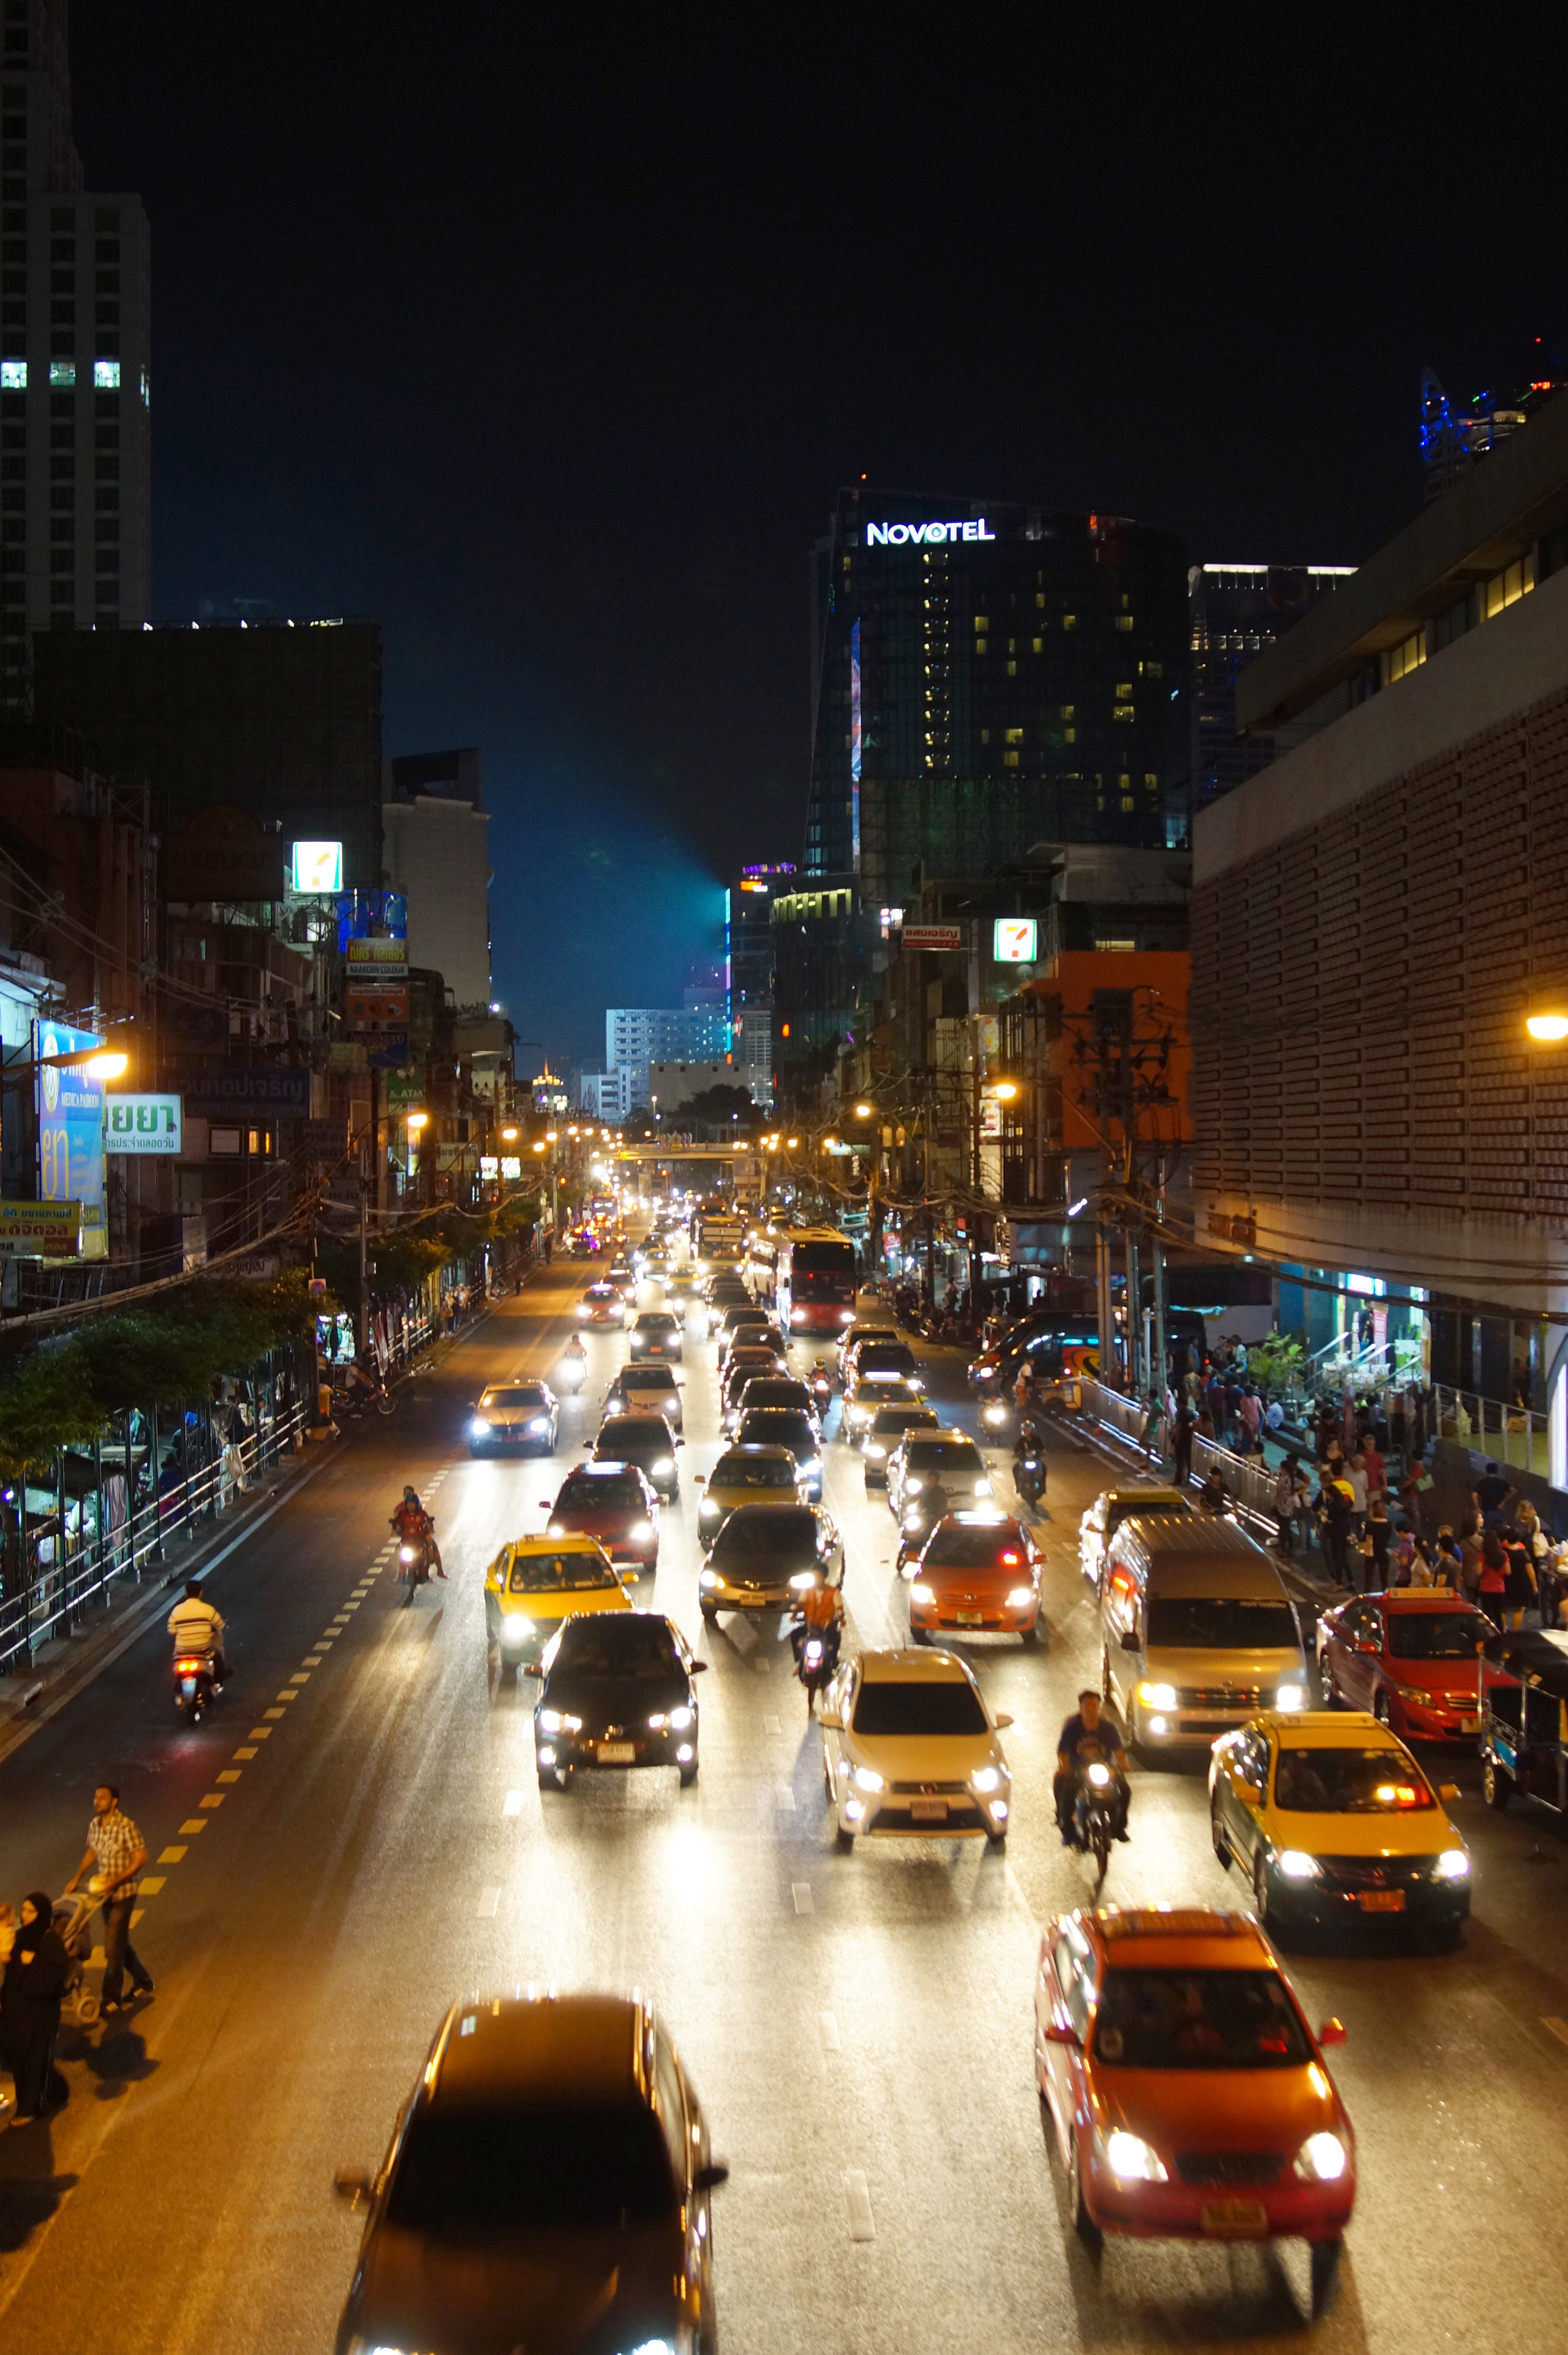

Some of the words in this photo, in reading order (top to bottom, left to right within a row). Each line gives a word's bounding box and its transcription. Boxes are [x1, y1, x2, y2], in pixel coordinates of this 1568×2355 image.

[867, 518, 996, 546] NOVOTEL
[350, 965, 379, 974] NAAKORN
[380, 965, 405, 974] COLOUR
[62, 1091, 80, 1107] MEDICA
